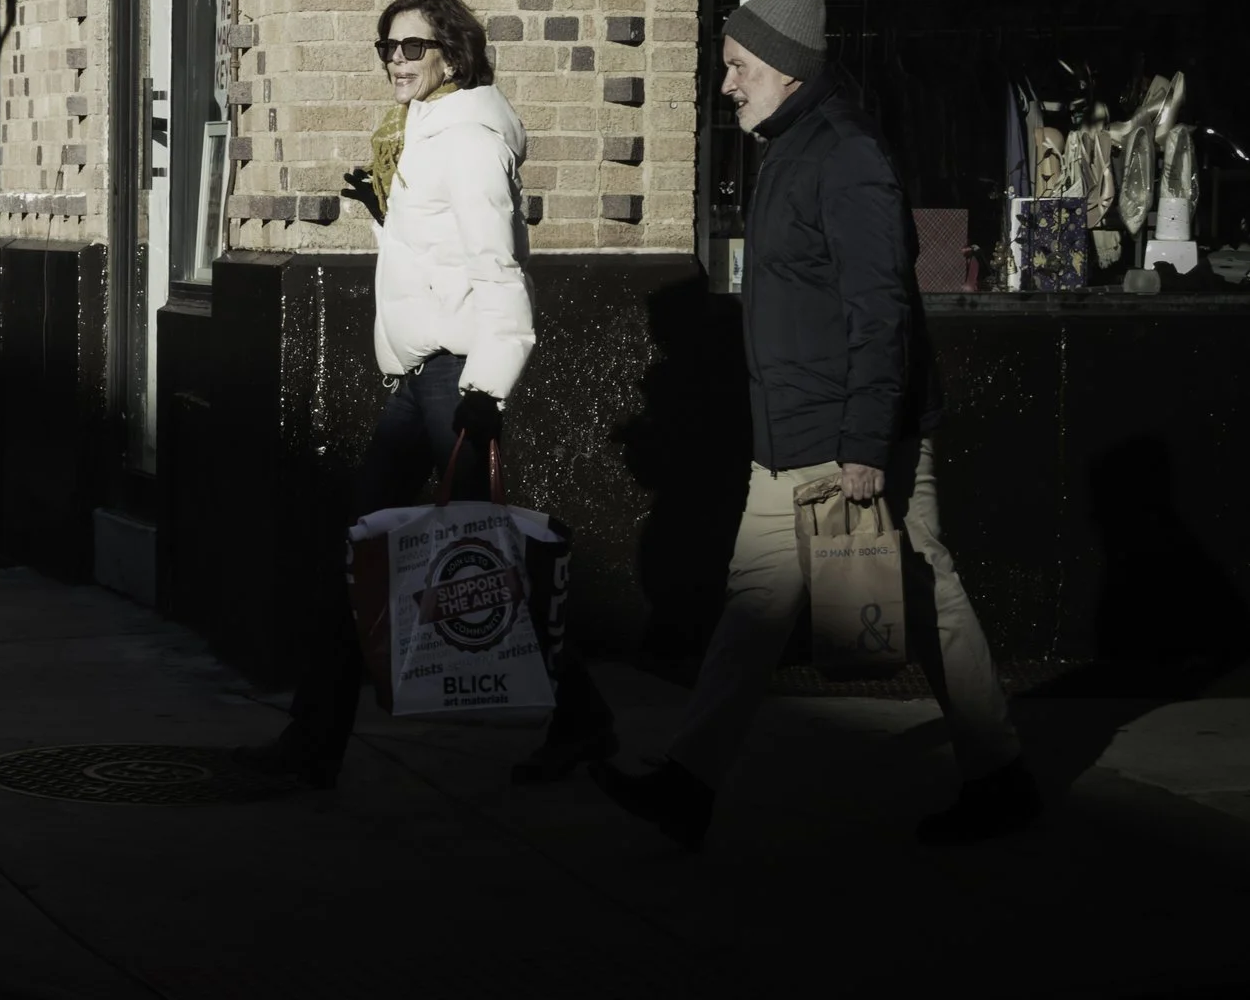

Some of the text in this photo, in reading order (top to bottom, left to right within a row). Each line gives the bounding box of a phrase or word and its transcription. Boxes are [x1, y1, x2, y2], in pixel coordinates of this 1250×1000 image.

[398, 534, 430, 552] fine
[435, 523, 459, 541] art
[446, 554, 488, 575] JOIN US TO
[829, 548, 856, 558] MANY
[437, 573, 507, 602] SUPPORT
[438, 587, 512, 616] THE ARTS
[453, 610, 502, 637] COMMUNITY
[857, 603, 898, 654] &
[401, 662, 443, 681] artists
[443, 673, 508, 695] BLICK
[443, 694, 509, 707] art materials
